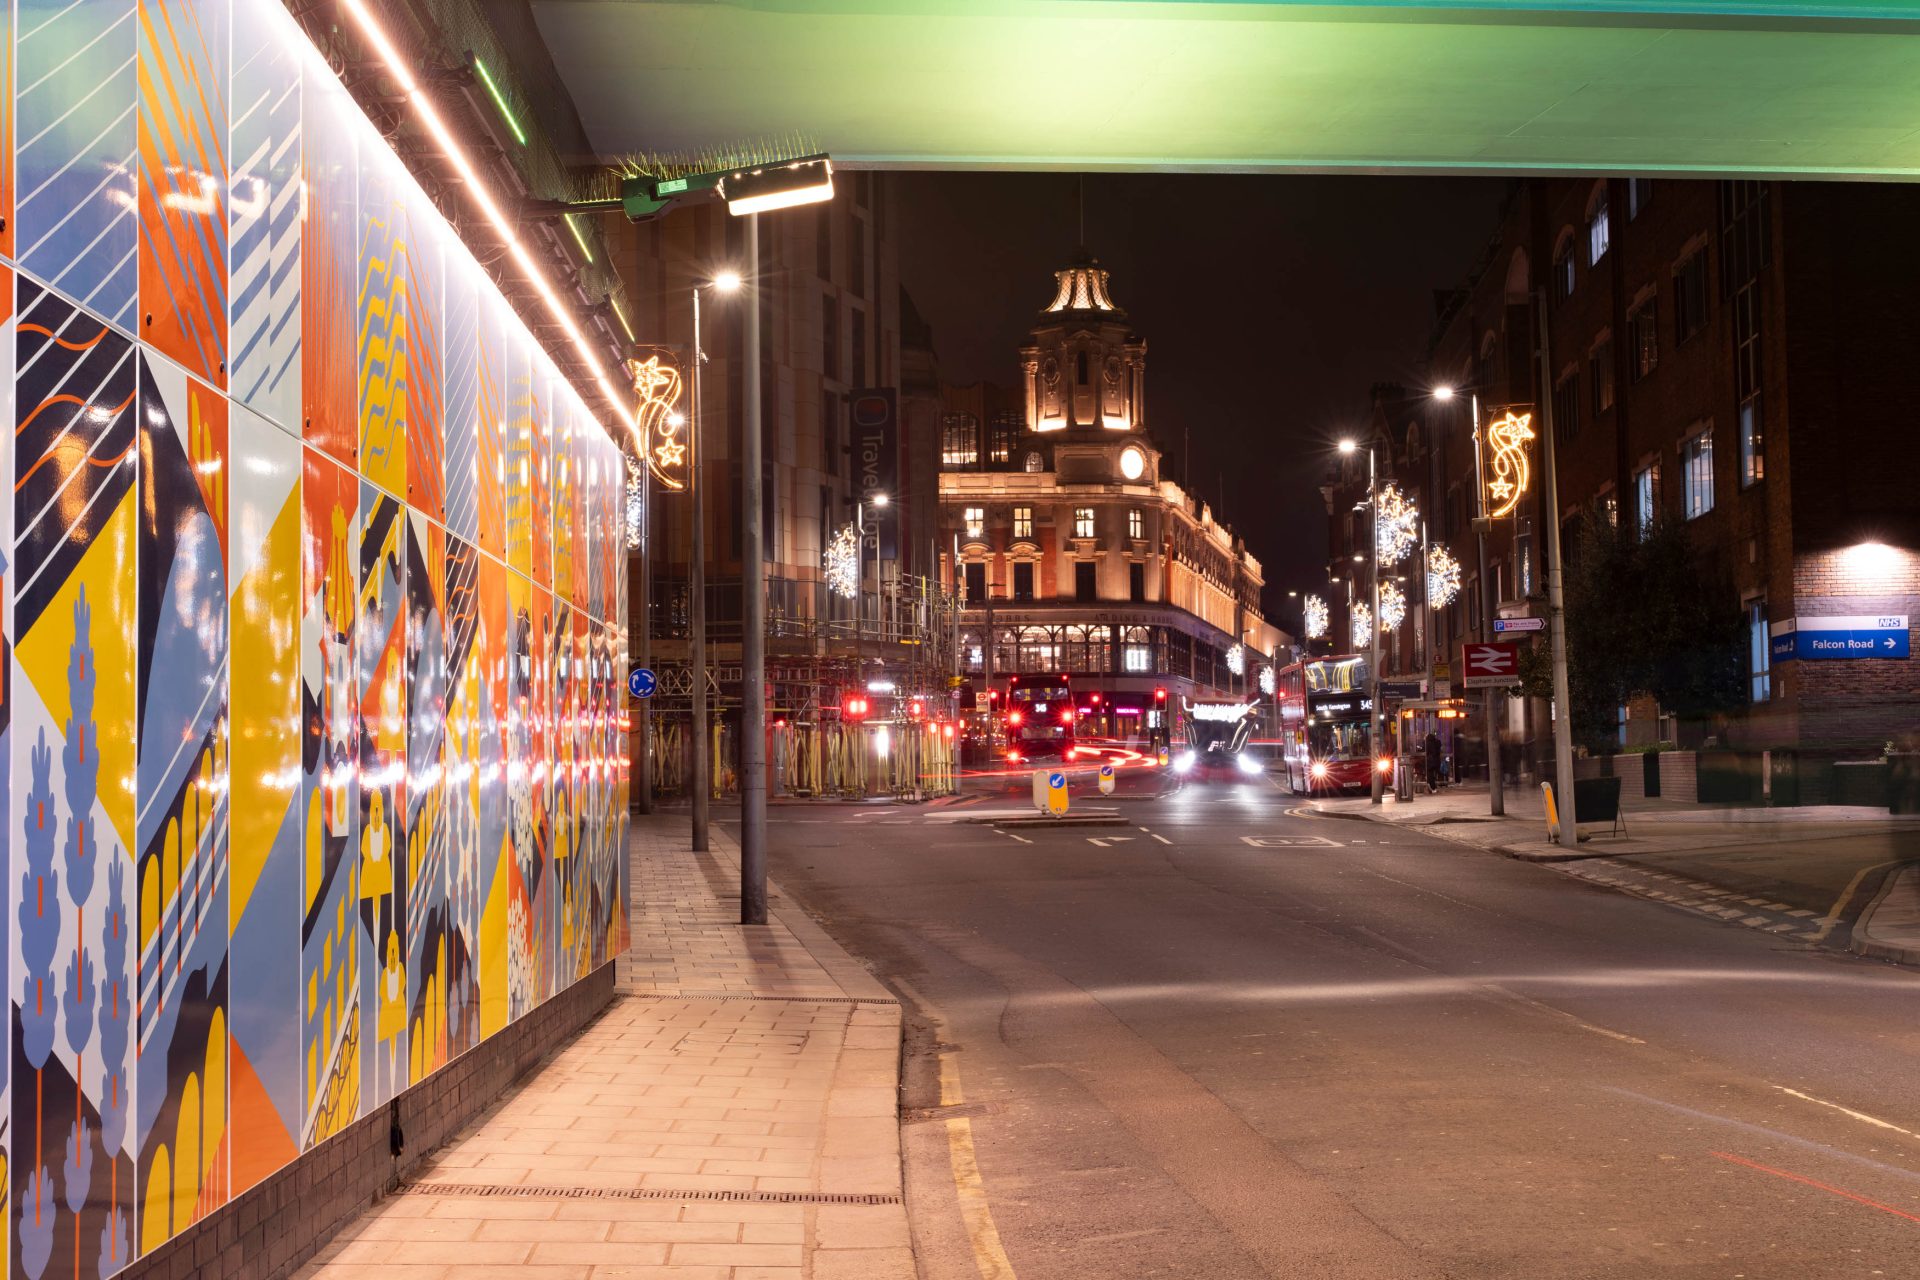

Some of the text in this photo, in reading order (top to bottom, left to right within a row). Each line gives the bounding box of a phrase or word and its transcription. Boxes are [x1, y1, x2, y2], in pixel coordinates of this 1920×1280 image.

[1497, 622, 1504, 630] P
[1879, 618, 1900, 627] NHS
[1812, 639, 1874, 649] Falcon Road
[1467, 678, 1492, 686] Clapham
[1328, 703, 1351, 711] Kensington
